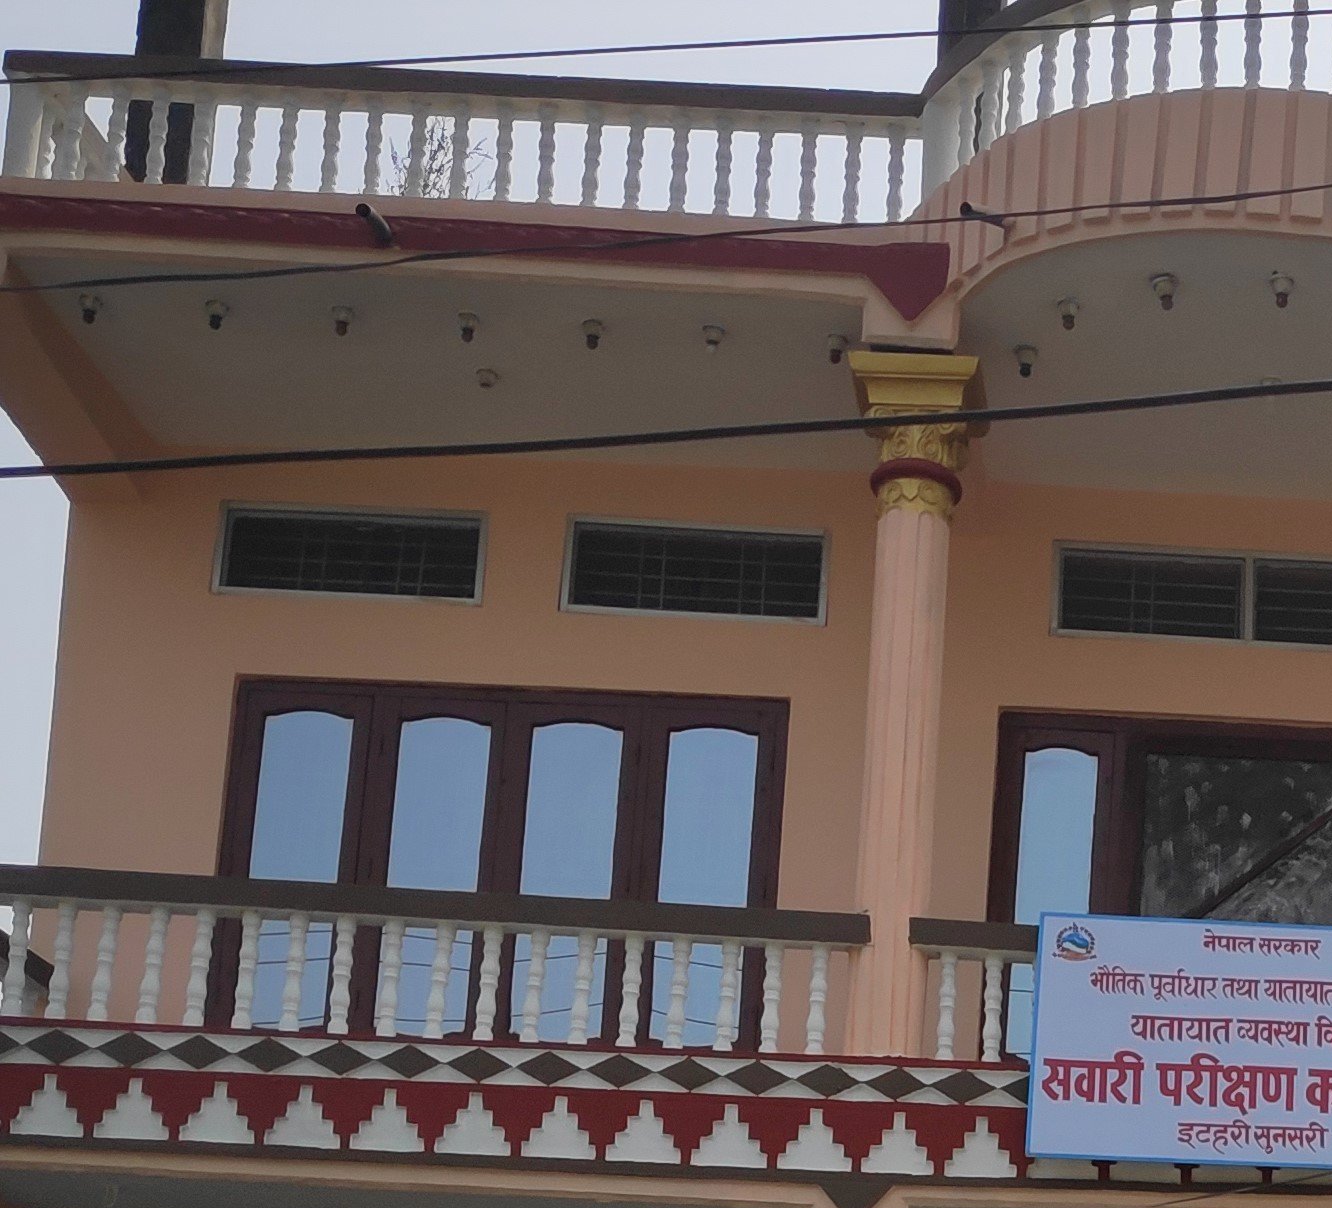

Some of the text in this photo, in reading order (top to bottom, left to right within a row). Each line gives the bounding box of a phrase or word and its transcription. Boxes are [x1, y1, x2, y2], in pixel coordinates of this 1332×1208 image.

[1203, 928, 1321, 959] नेपाल सरकार
[1090, 965, 1145, 996] भौतिक
[1149, 968, 1218, 1002] पूर्वाधार
[1223, 978, 1260, 1000] तथा
[1131, 1015, 1233, 1045] यातायात
[1237, 1019, 1309, 1048] व्यवस्था
[1041, 1051, 1145, 1105] सवारी
[1156, 1053, 1297, 1115] परीक्षण
[1177, 1119, 1329, 1154] इटहरी सुनसरी
